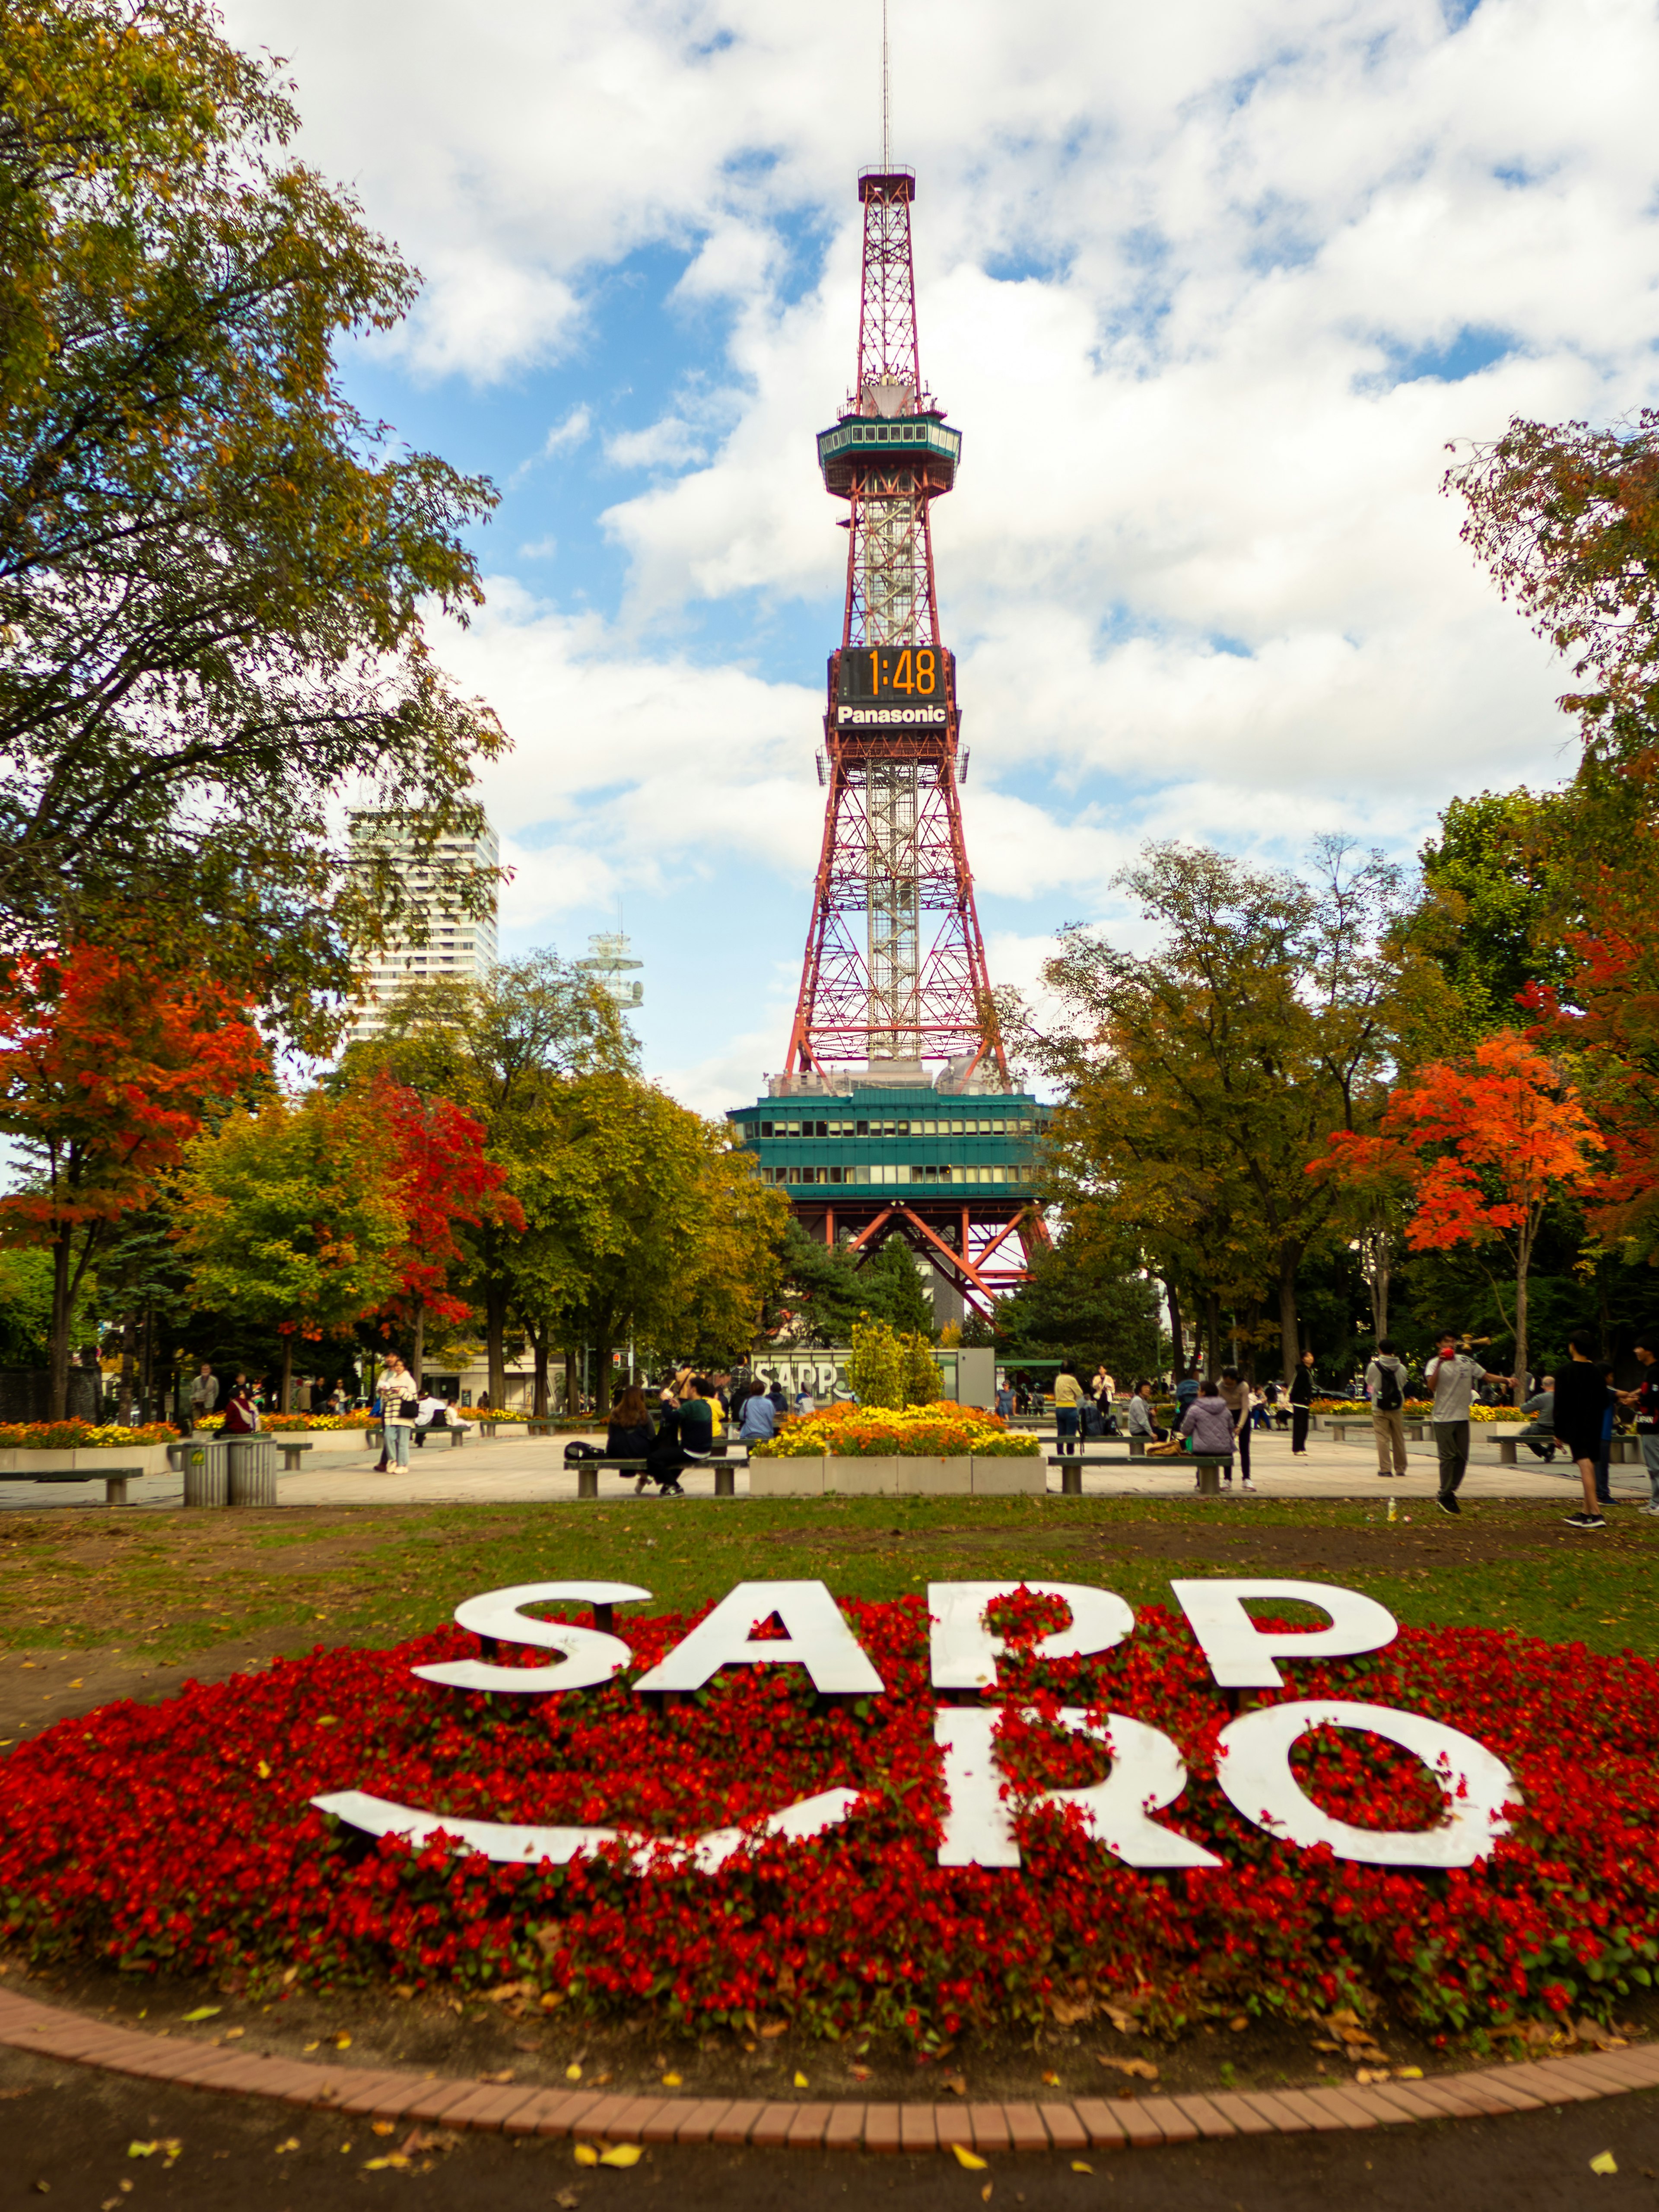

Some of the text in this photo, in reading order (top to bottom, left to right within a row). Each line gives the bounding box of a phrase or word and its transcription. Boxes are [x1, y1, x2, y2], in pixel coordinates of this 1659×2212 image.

[870, 649, 935, 695] 1:48
[838, 705, 946, 724] Panasonic
[410, 1579, 1398, 1693] SAPP
[934, 1700, 1524, 1868] RO
